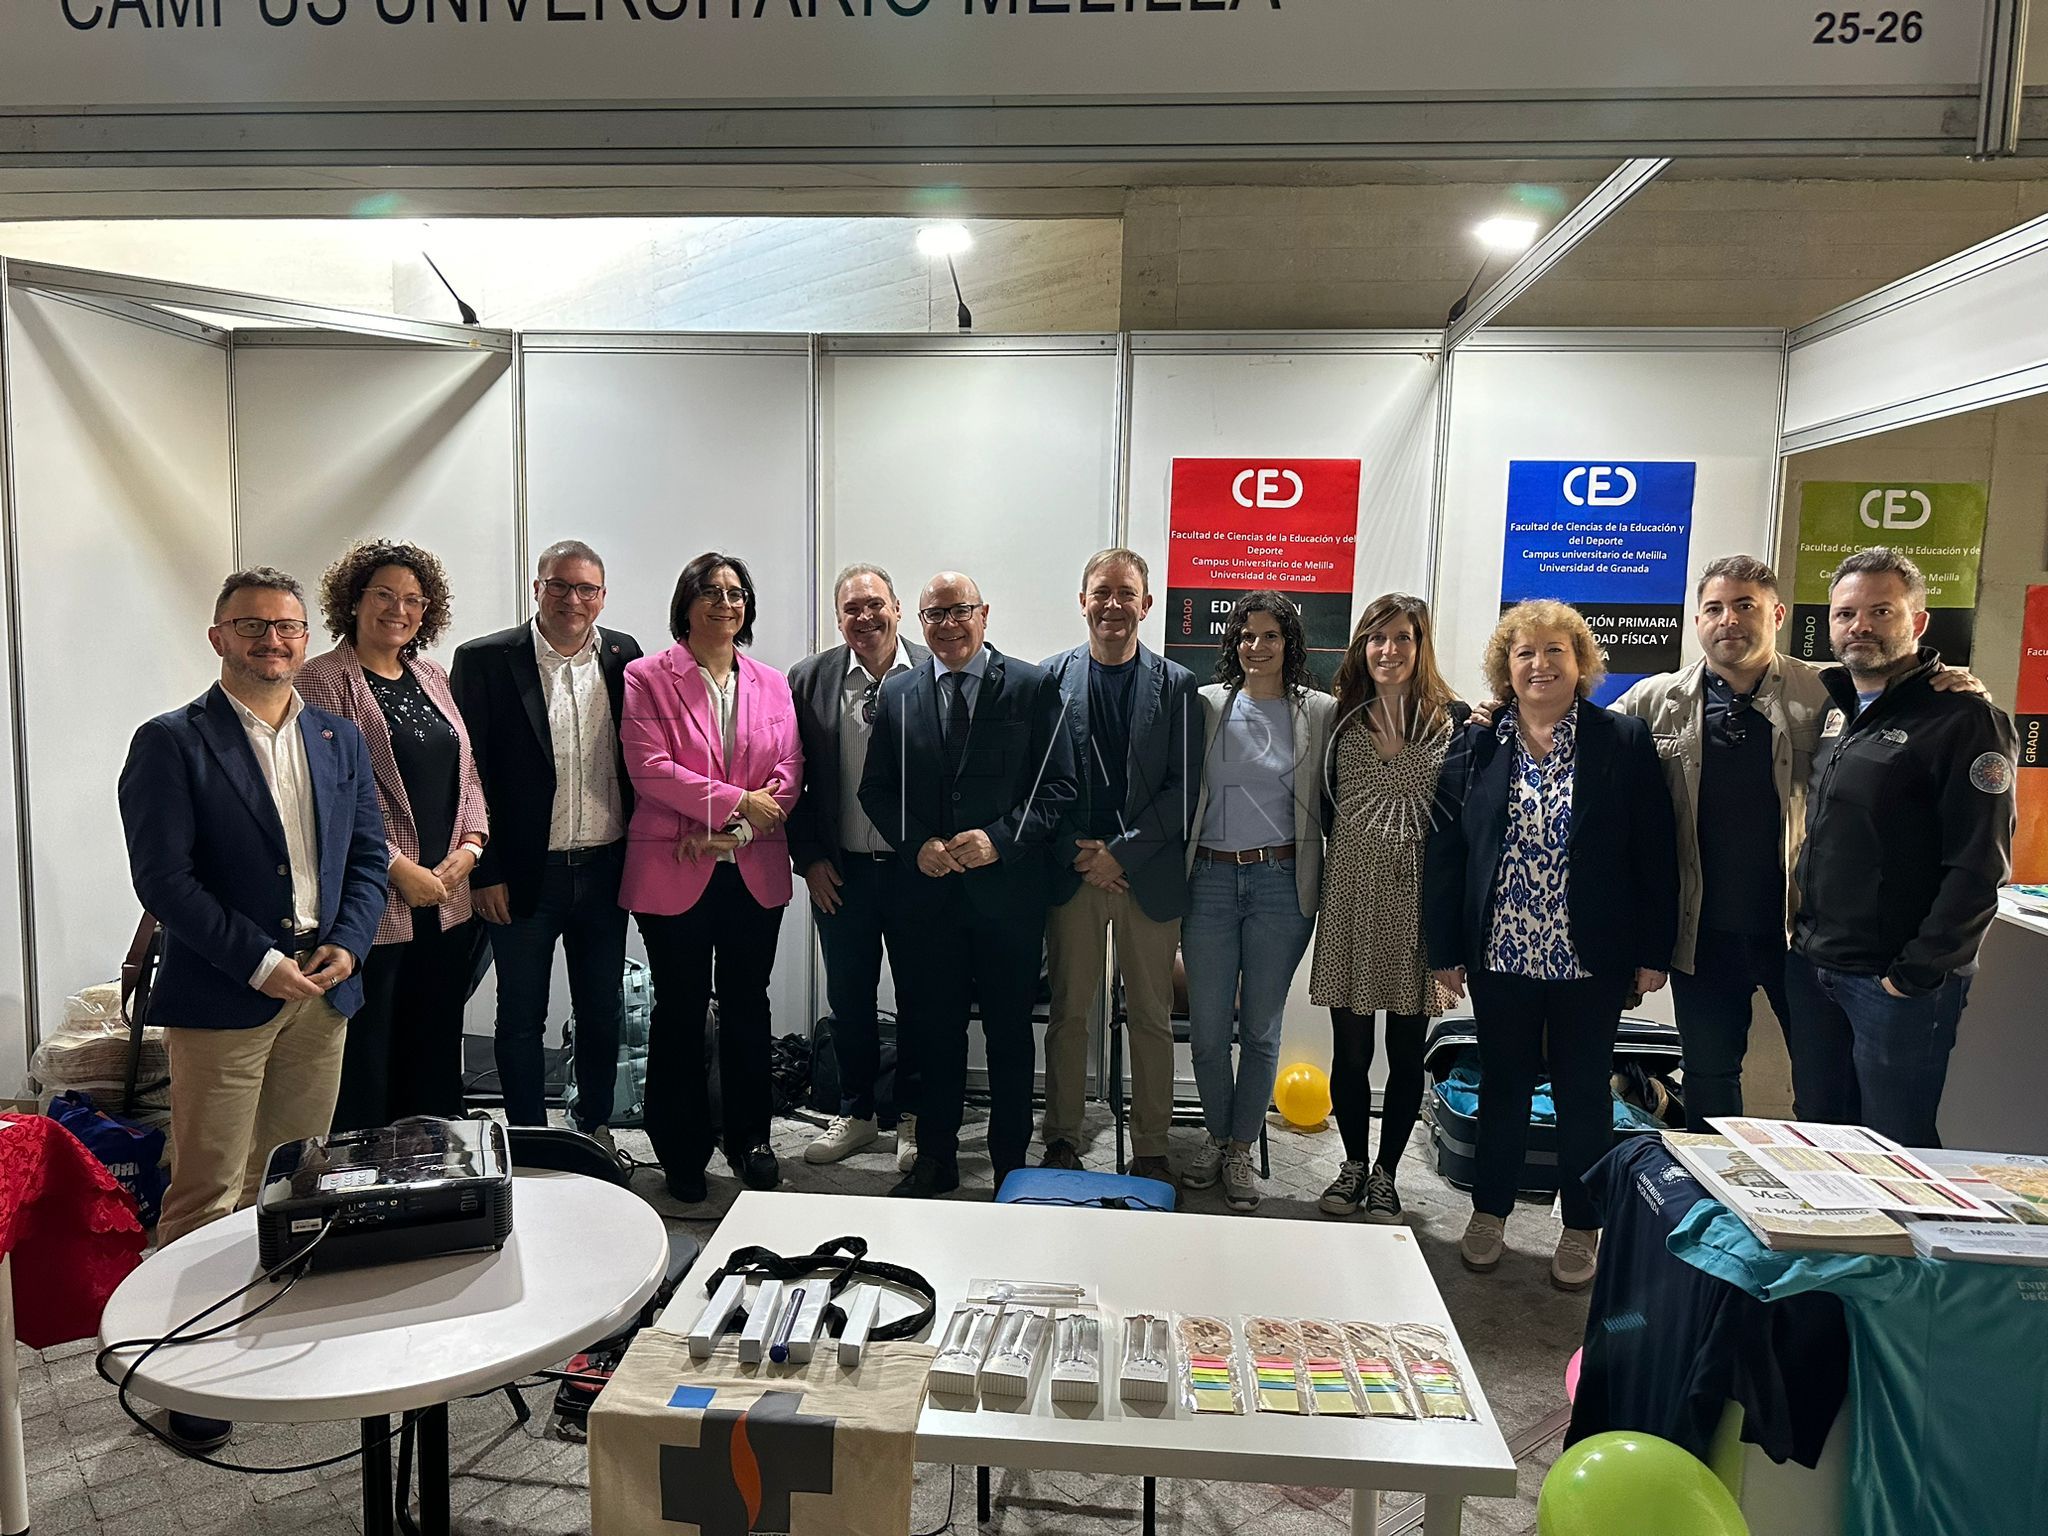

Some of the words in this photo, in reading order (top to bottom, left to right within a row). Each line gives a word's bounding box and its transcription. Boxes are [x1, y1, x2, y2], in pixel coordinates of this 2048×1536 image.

[1812, 11, 1923, 44] 25-26
[1510, 522, 1549, 531] Facultad
[1551, 522, 1564, 531] de
[1565, 522, 1603, 531] Ciencias
[1605, 522, 1617, 532] de
[1619, 523, 1628, 532] la
[1630, 522, 1677, 532] Educación
[1679, 525, 1685, 534] y
[1171, 530, 1211, 539] Facultad
[1213, 531, 1224, 539] de
[1227, 532, 1264, 541] Ciencias
[1266, 533, 1277, 541] de
[1279, 533, 1287, 542] la
[1289, 534, 1334, 543] Educación
[1335, 536, 1341, 544] y
[1568, 536, 1584, 545] del
[1586, 536, 1624, 547] Deporte
[1247, 546, 1284, 556] Deporte
[1522, 550, 1560, 560] Campus
[1561, 550, 1620, 559] universitario
[1622, 550, 1634, 559] de
[1636, 550, 1667, 560] Melilla
[1800, 543, 1839, 552] Facultad
[1840, 544, 1852, 552] de
[1891, 546, 1904, 554] de
[1905, 546, 1914, 554] la
[1916, 546, 1961, 555] Educación
[1963, 548, 1969, 556] y
[1192, 557, 1230, 567] Campus
[1231, 558, 1289, 568] Universitario
[1291, 560, 1302, 568] de
[1304, 561, 1334, 569] Melilla
[1539, 563, 1595, 572] Universidad
[1596, 563, 1608, 572] de
[1610, 564, 1649, 573] Granada
[1210, 570, 1264, 580] Universidad
[1266, 572, 1277, 580] de
[1279, 573, 1316, 582] Granada
[1928, 573, 1960, 582] Melilla
[1182, 598, 1193, 635] GRADO
[1618, 617, 1678, 628] PRIMARIA
[1621, 631, 1658, 645] FÍSICA
[1660, 634, 1669, 645] Y
[1803, 616, 1816, 657] GRADO
[2025, 721, 2040, 763] GRADO
